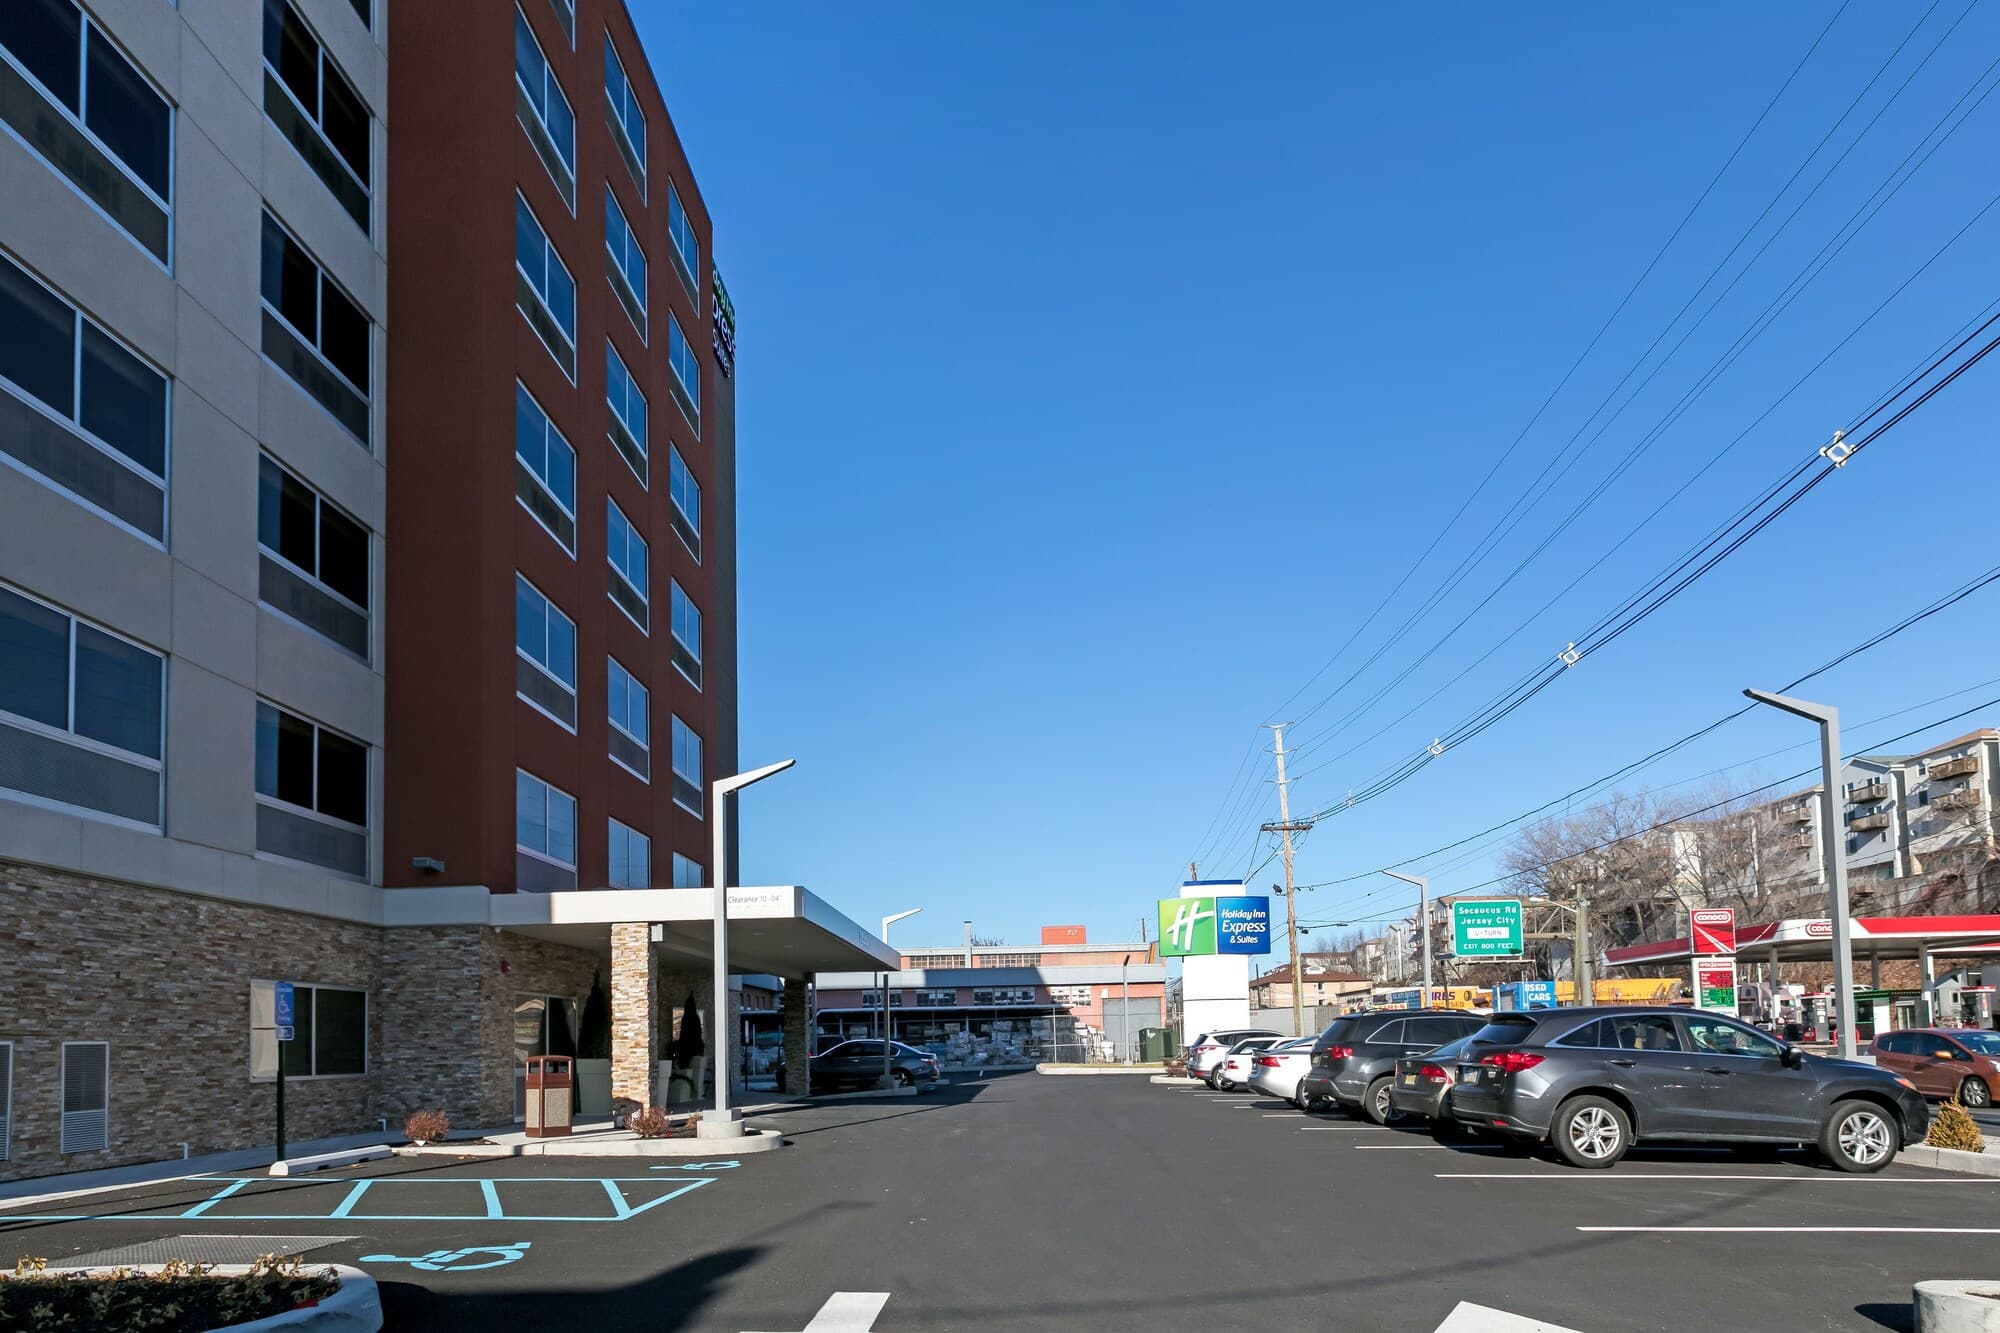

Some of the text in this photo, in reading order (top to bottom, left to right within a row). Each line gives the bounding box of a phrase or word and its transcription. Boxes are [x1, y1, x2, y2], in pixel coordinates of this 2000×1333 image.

[727, 896, 759, 904] Clearance
[1221, 908, 1266, 921] Holiday Inn
[1458, 905, 1517, 915] Secaucus Rd
[1460, 916, 1516, 926] Jersey City
[1697, 913, 1728, 921] conoco
[1222, 919, 1266, 935] Express
[1230, 935, 1259, 944] & Suites
[1524, 983, 1547, 992] USED
[1431, 991, 1456, 1001] IRES
[1528, 992, 1551, 1001] CARS
